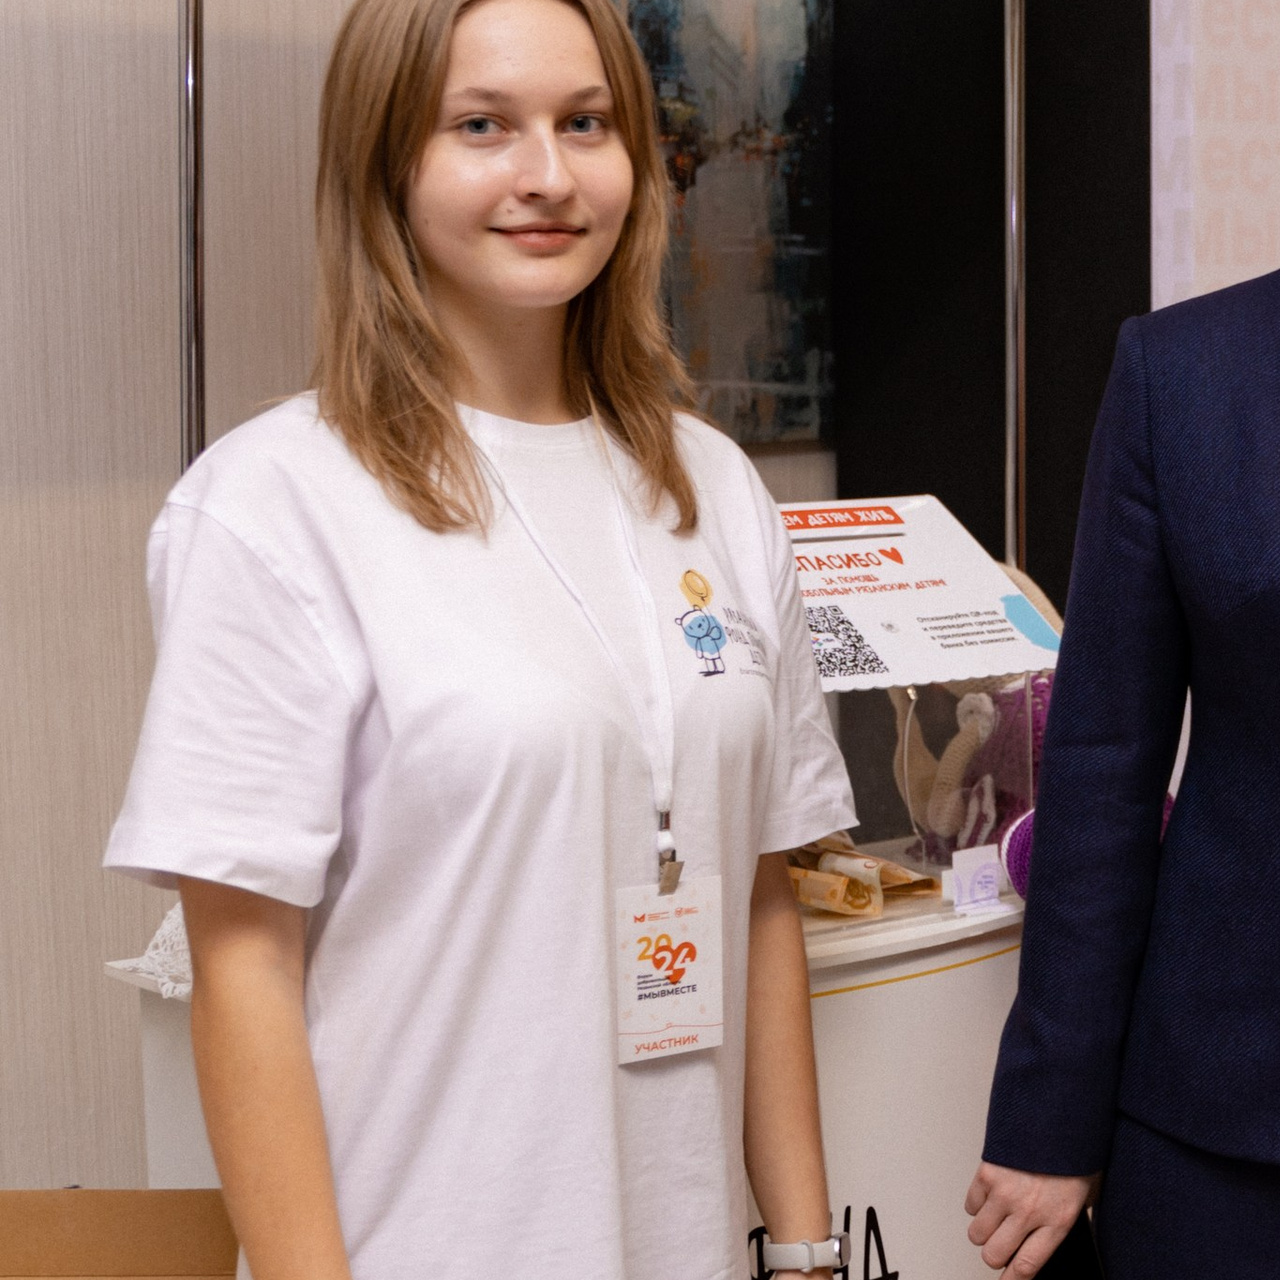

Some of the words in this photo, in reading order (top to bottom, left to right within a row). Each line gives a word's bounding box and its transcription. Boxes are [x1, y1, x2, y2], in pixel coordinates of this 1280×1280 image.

[807, 512, 855, 527] ДЕТЯМ
[795, 552, 882, 572] ПАСИБО
[637, 984, 697, 1001] #МЫВМЕСТЕ
[635, 1034, 699, 1054] УЧАСТНИК
